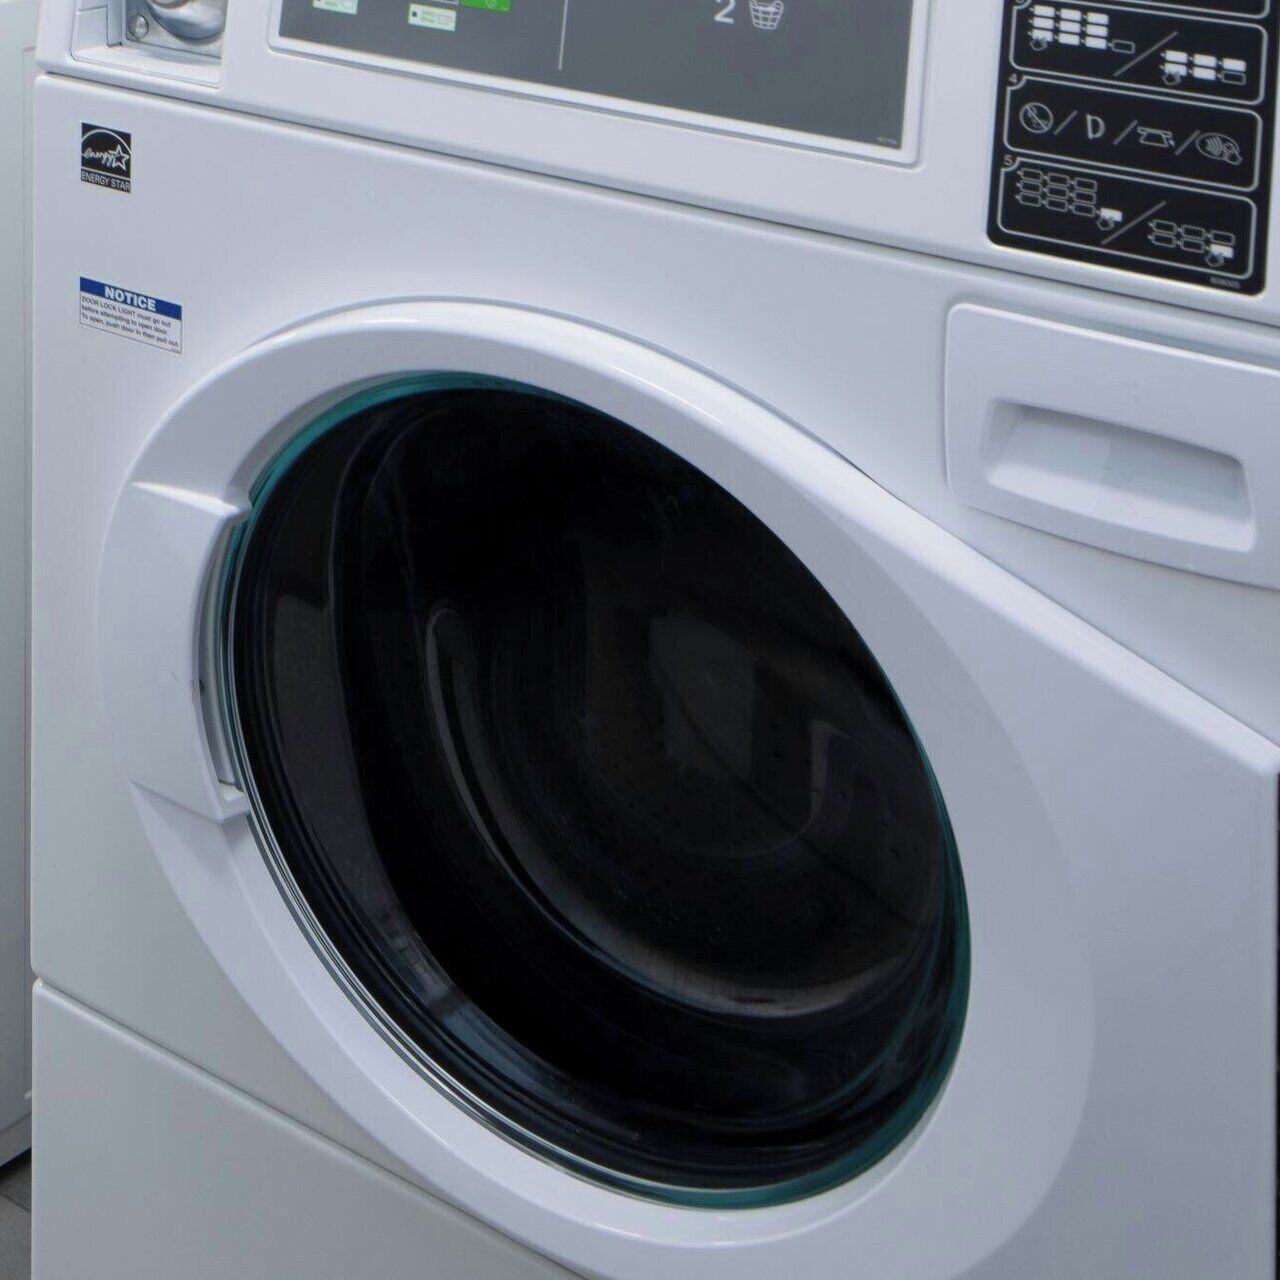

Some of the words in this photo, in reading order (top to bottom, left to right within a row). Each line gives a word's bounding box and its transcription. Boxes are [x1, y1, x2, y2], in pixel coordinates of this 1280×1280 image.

[1009, 74, 1018, 85] 4
[1003, 155, 1013, 166] 5
[81, 171, 110, 186] ENERGY
[111, 178, 130, 191] STAR
[82, 296, 99, 306] DOOR
[100, 301, 117, 312] LOCK
[118, 305, 136, 318] LIGHT
[104, 286, 157, 312] NOTICE
